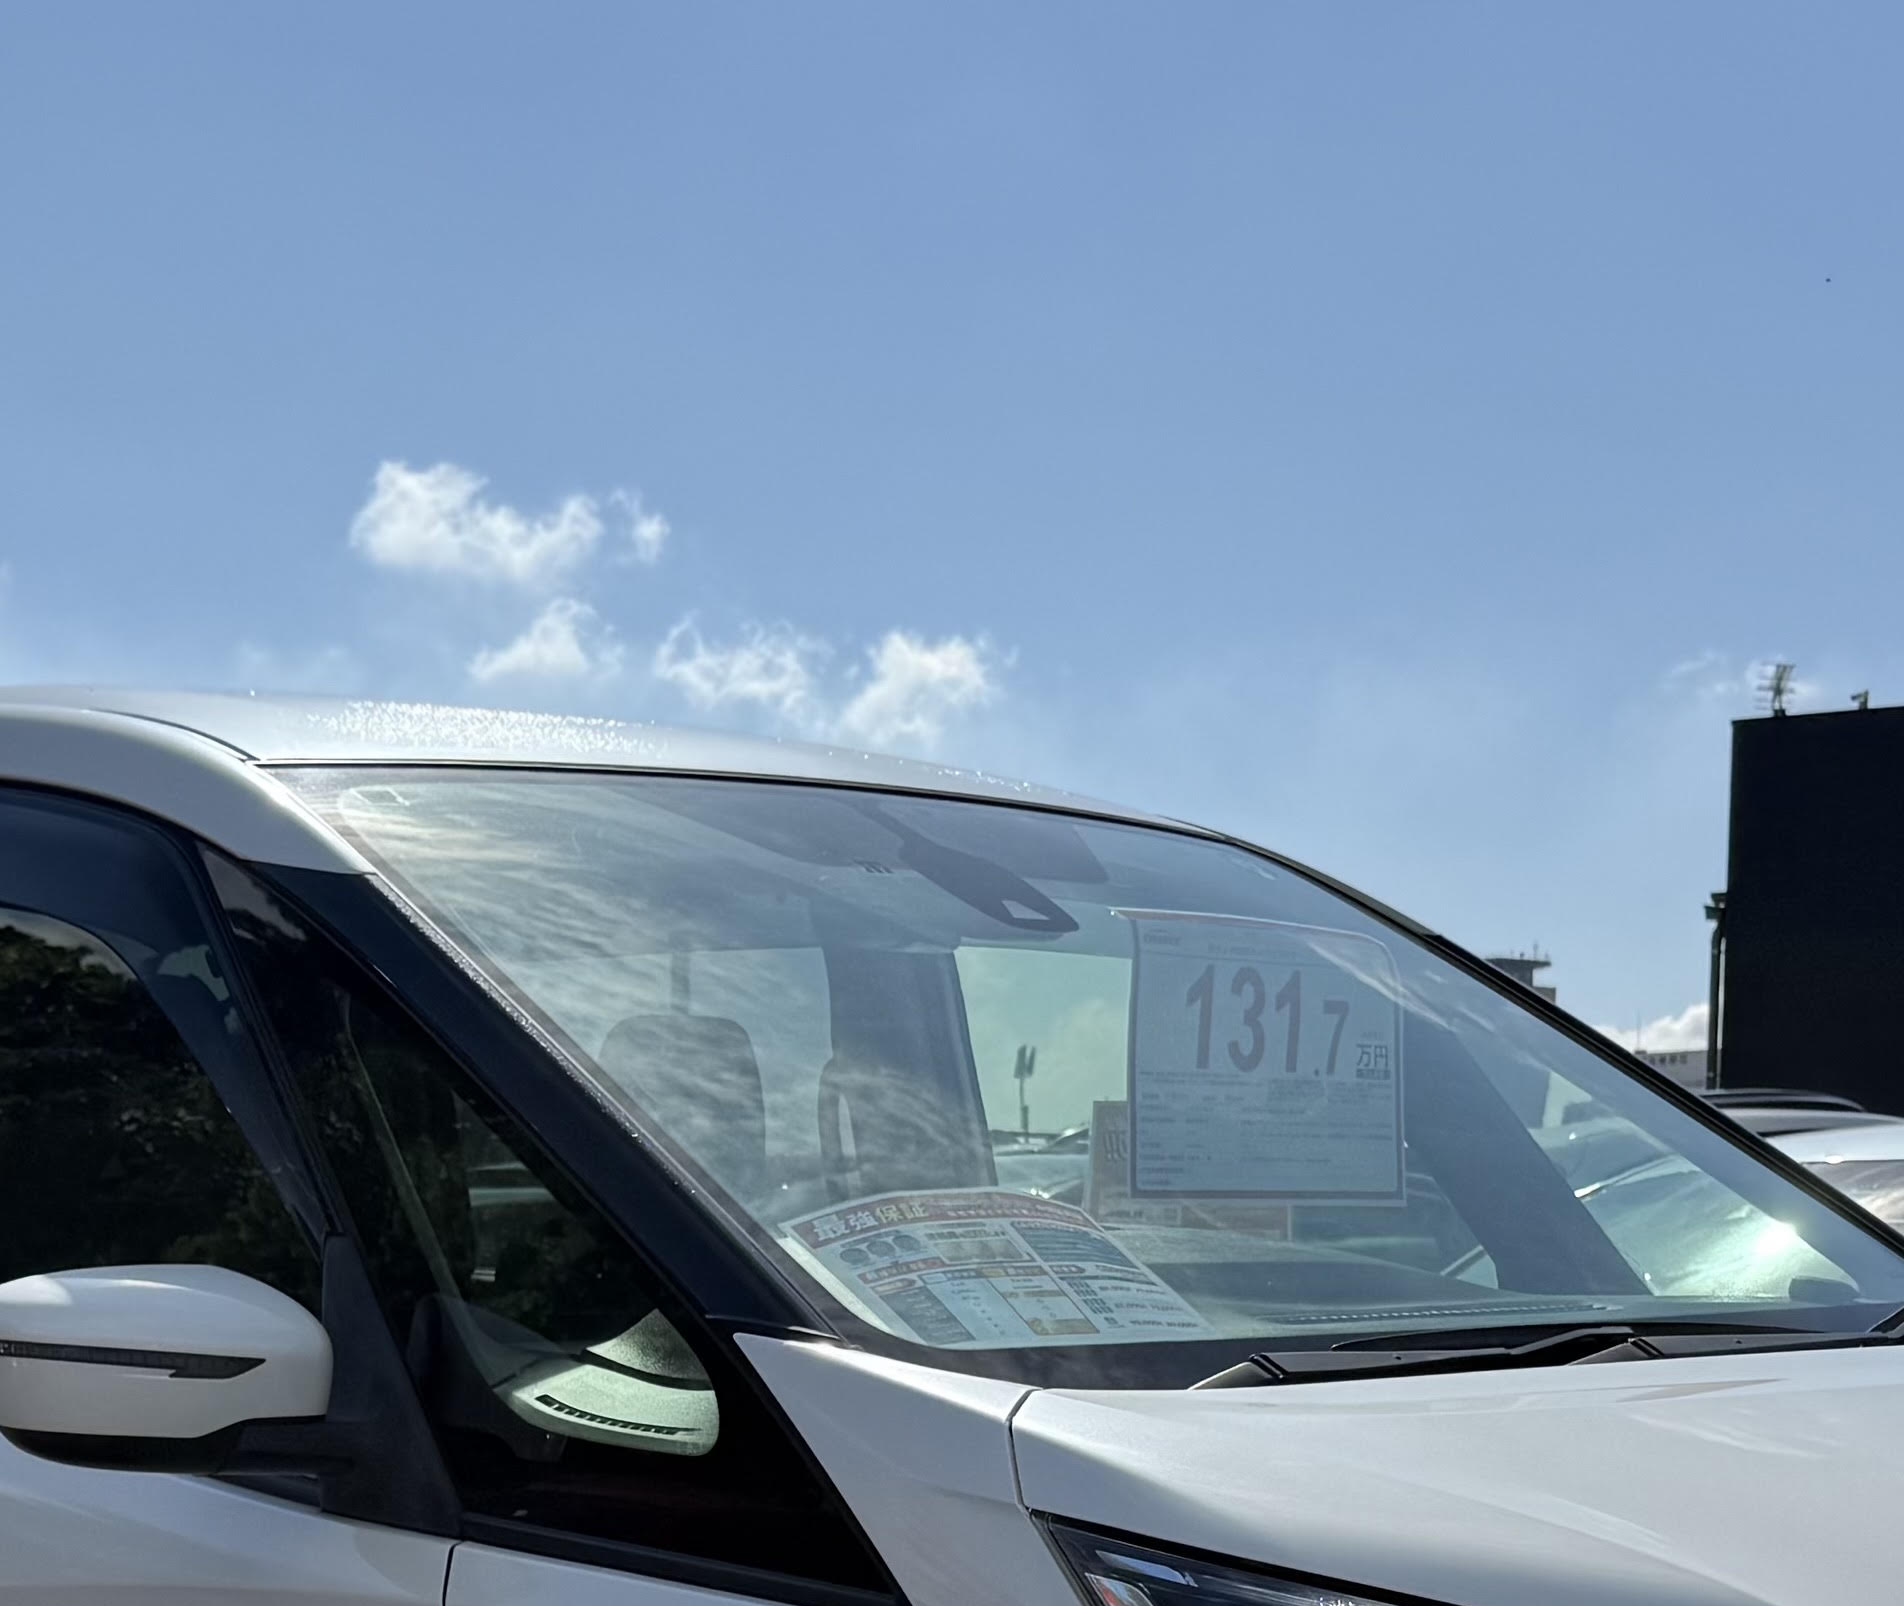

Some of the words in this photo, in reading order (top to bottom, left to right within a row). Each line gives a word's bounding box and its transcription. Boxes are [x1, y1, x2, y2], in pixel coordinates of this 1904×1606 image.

[1186, 964, 1350, 1077] 131.7
[1356, 1044, 1389, 1068] 万円
[812, 1200, 929, 1241] 最強保証
